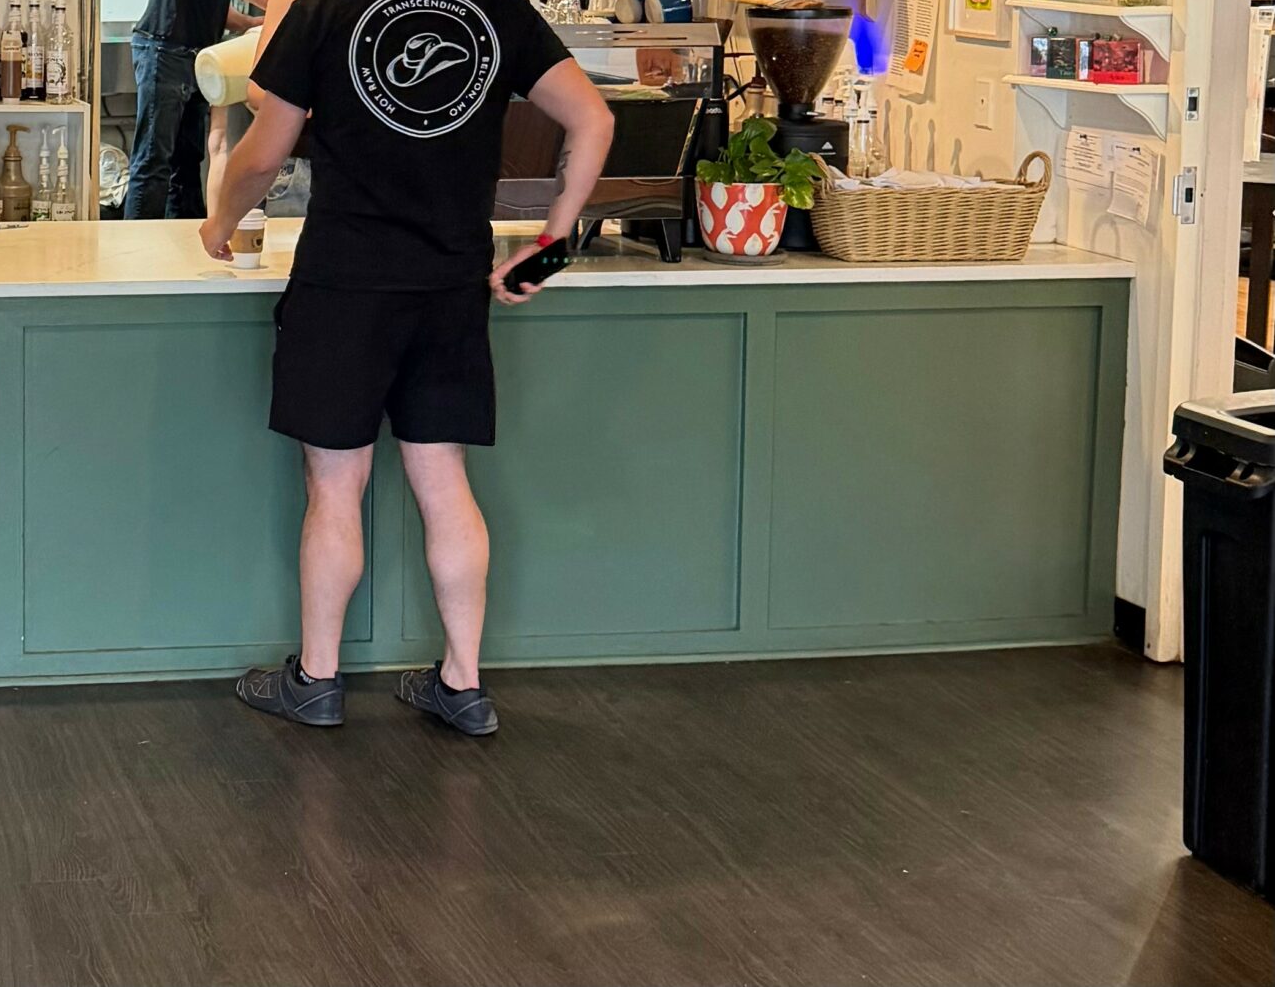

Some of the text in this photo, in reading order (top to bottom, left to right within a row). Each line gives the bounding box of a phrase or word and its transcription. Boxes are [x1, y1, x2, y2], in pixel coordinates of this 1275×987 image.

[360, 66, 396, 114] HOT RAW
[449, 101, 467, 117] MO
